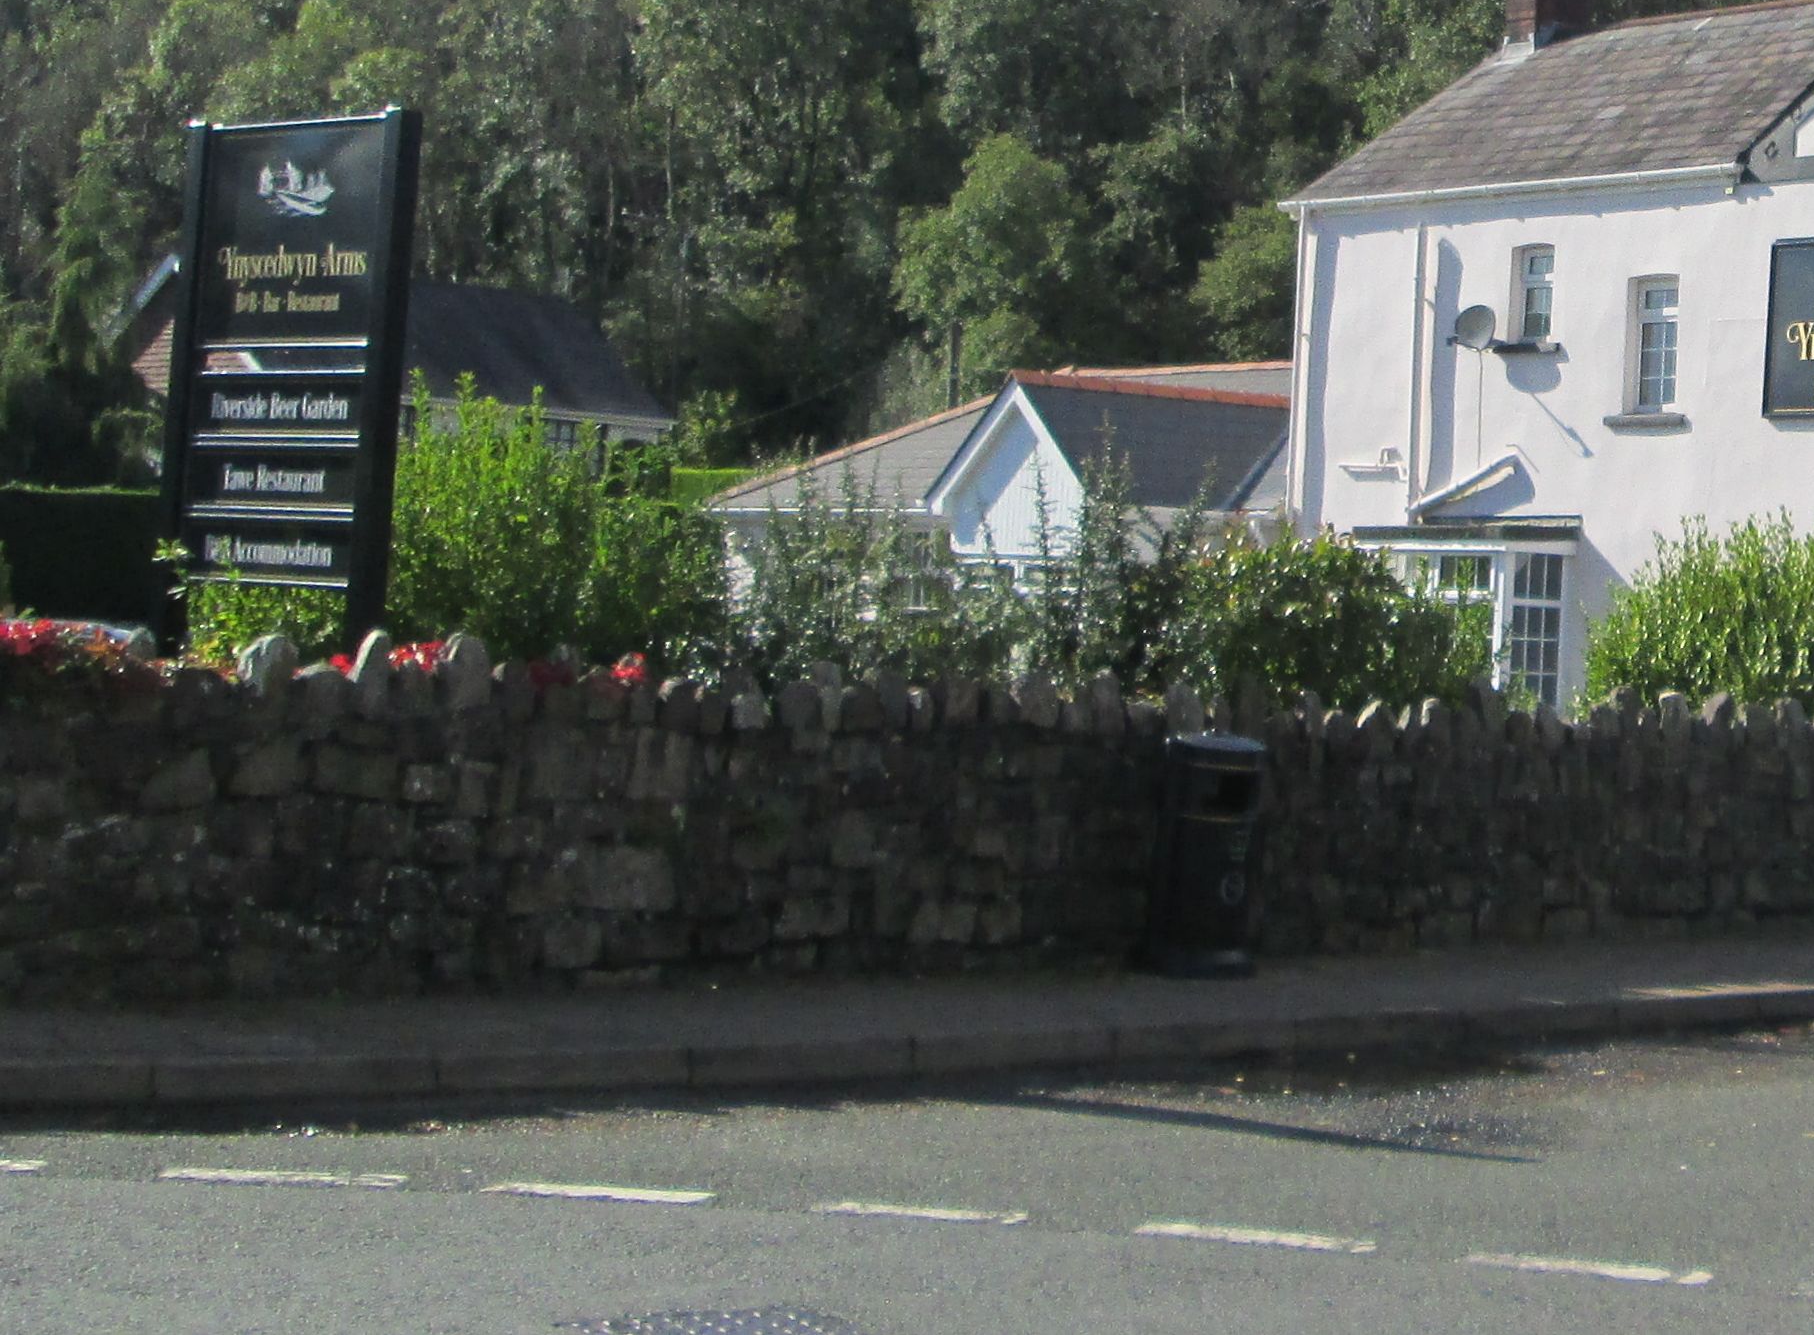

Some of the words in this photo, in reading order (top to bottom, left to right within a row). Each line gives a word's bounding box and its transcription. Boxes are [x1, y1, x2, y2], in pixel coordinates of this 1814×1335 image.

[218, 244, 317, 287] Ynyscedwyn
[320, 242, 368, 277] Arms
[263, 290, 281, 312] Bar
[287, 291, 340, 312] Restaurant
[211, 392, 268, 419] Riverside
[270, 392, 299, 420] Beer
[302, 392, 348, 420] Garden
[256, 464, 325, 493] Restaurant
[234, 536, 332, 566] Accommodation
